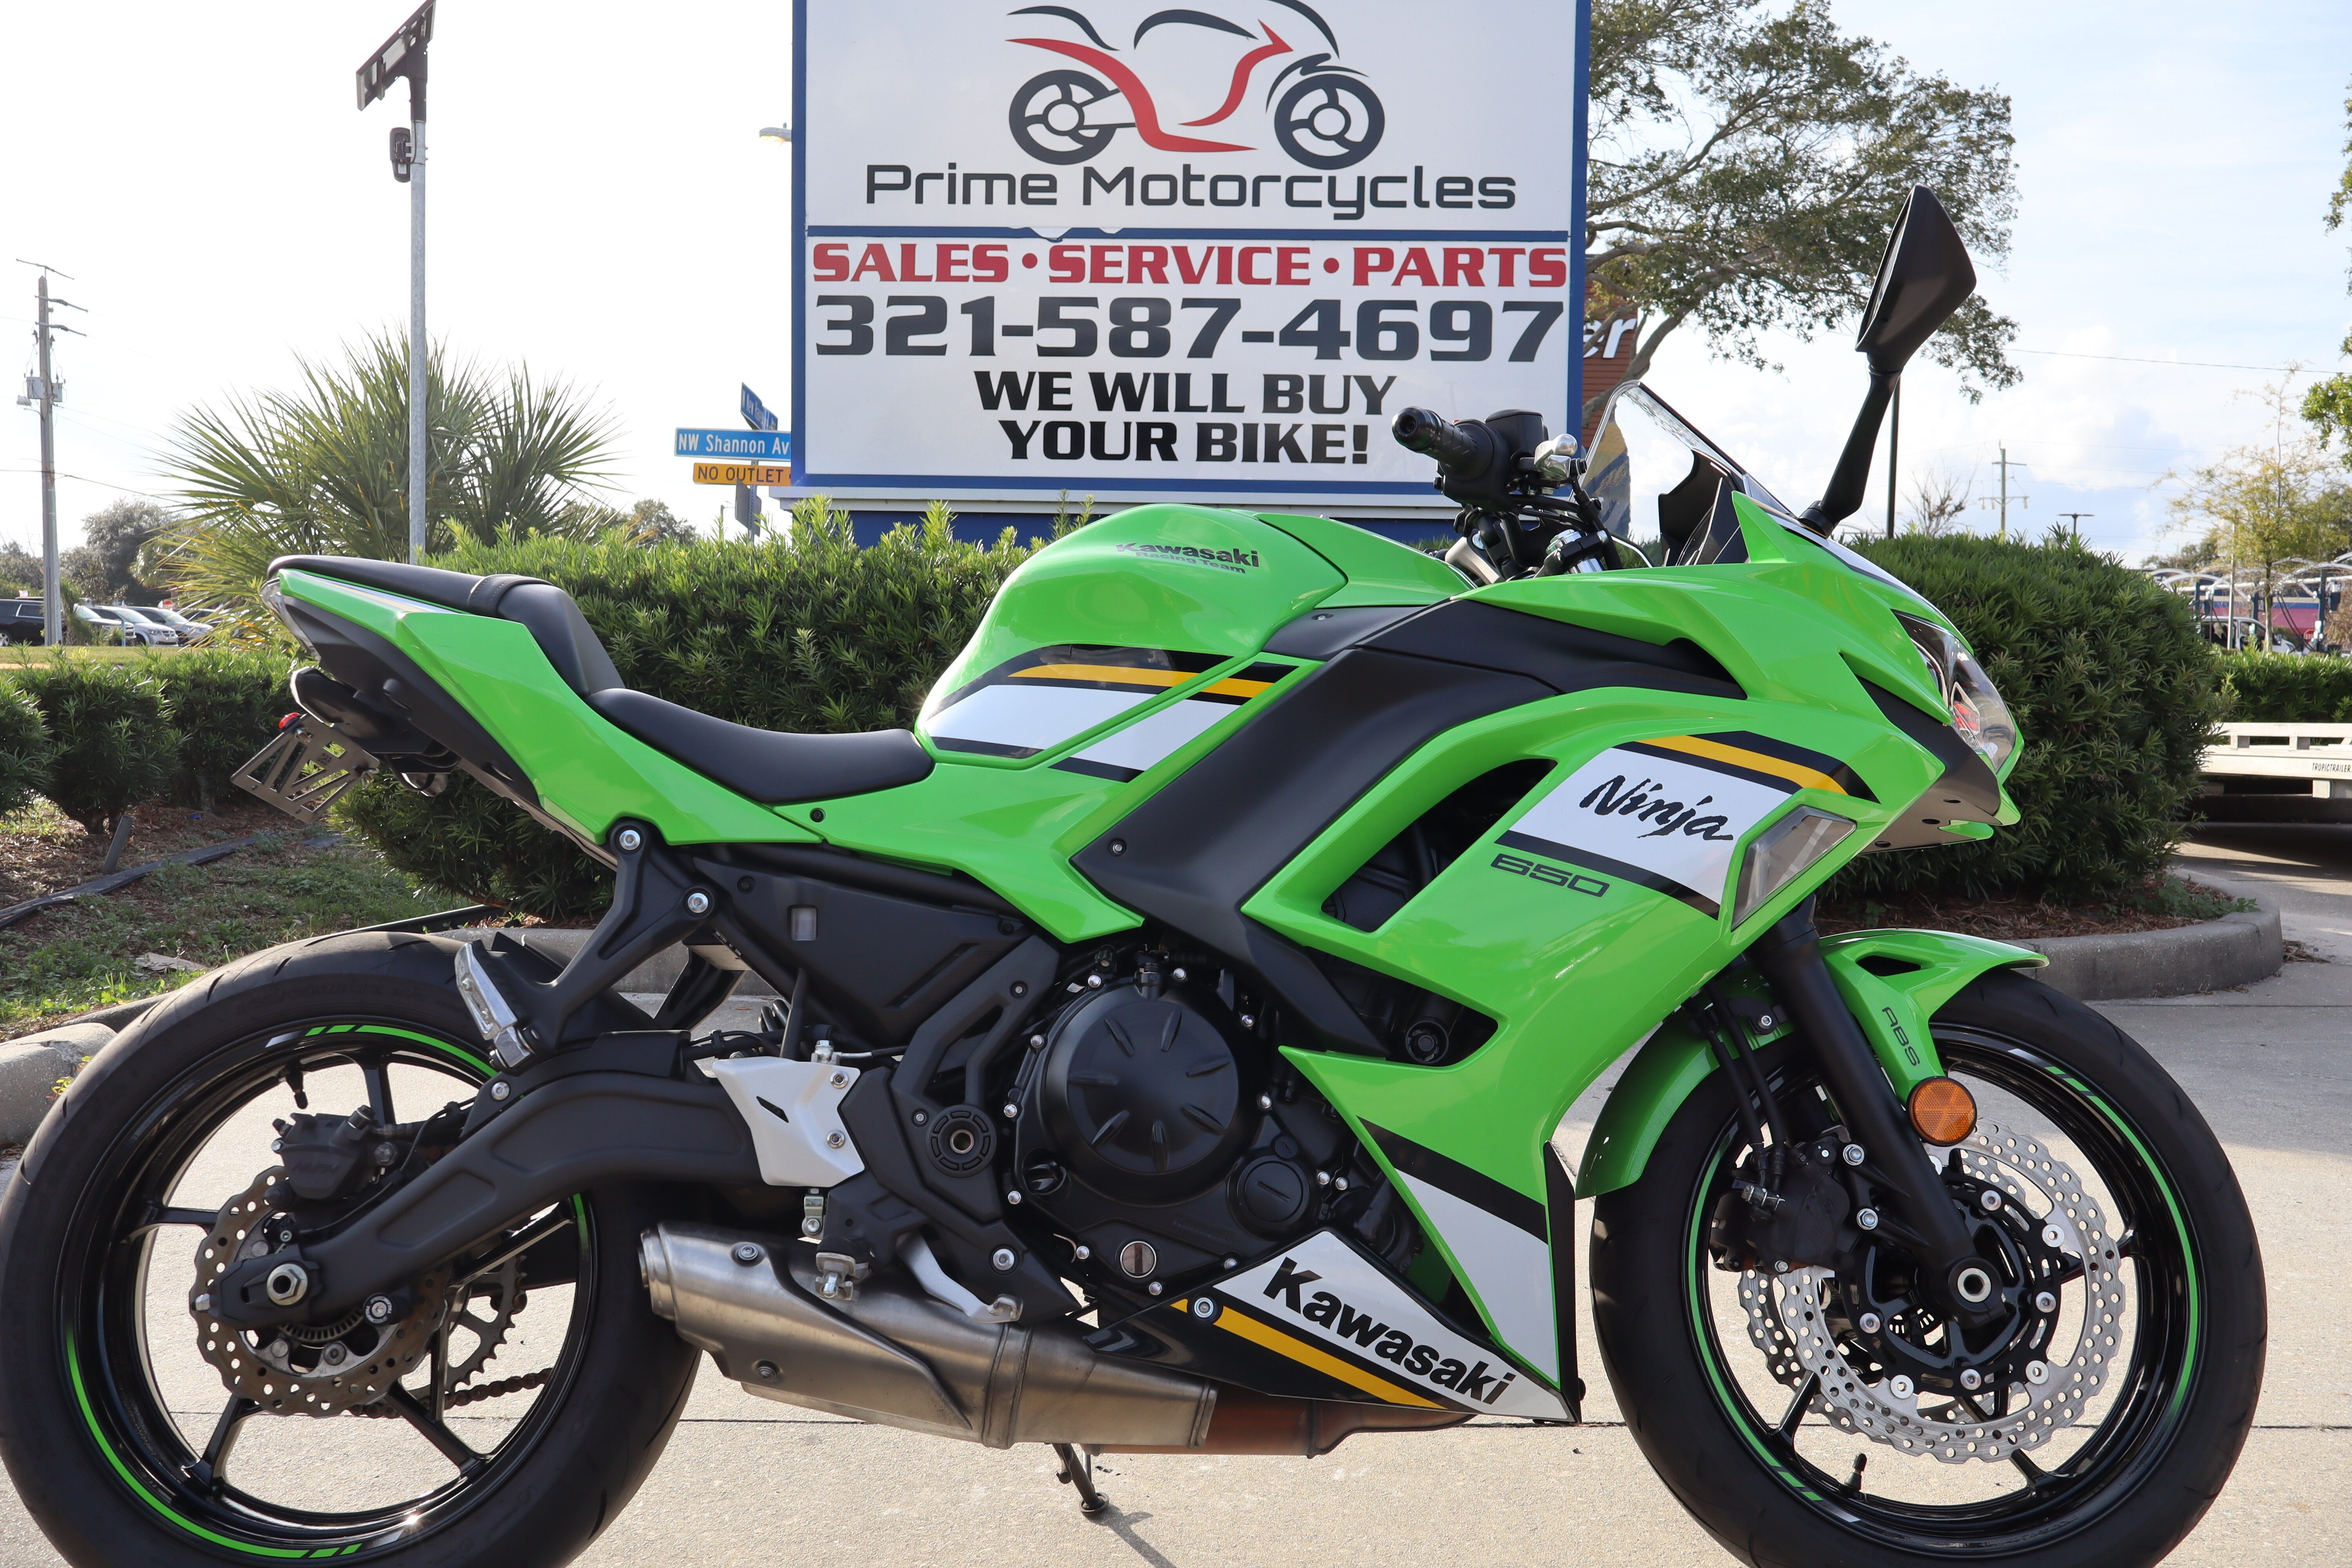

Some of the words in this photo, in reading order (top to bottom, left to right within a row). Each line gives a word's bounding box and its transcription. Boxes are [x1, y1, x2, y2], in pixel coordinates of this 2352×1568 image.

[867, 163, 1057, 205] Prime
[1083, 164, 1516, 220] Motorcycles
[813, 244, 1009, 282] SALES
[1049, 245, 1311, 285] SERVICE
[1353, 248, 1566, 287] PARTS
[816, 296, 1564, 362] 321-587-4697
[974, 371, 1073, 411] WE
[1089, 372, 1245, 413] WILL
[1262, 374, 1397, 415] BUY
[678, 433, 699, 451] NW
[706, 434, 765, 454] Shannon
[998, 420, 1178, 461] YOUR
[1196, 423, 1368, 464] BIKE!
[698, 466, 719, 480] NO
[726, 467, 784, 483] OUTLET
[1116, 543, 1260, 567] Kawasaki
[1136, 552, 1197, 564] Racing
[1199, 559, 1246, 574] Team
[1579, 775, 1733, 841] Ninja
[1491, 853, 1610, 897] 650
[1882, 1007, 1920, 1066] ABS
[1263, 1256, 1516, 1405] Kawasaki
